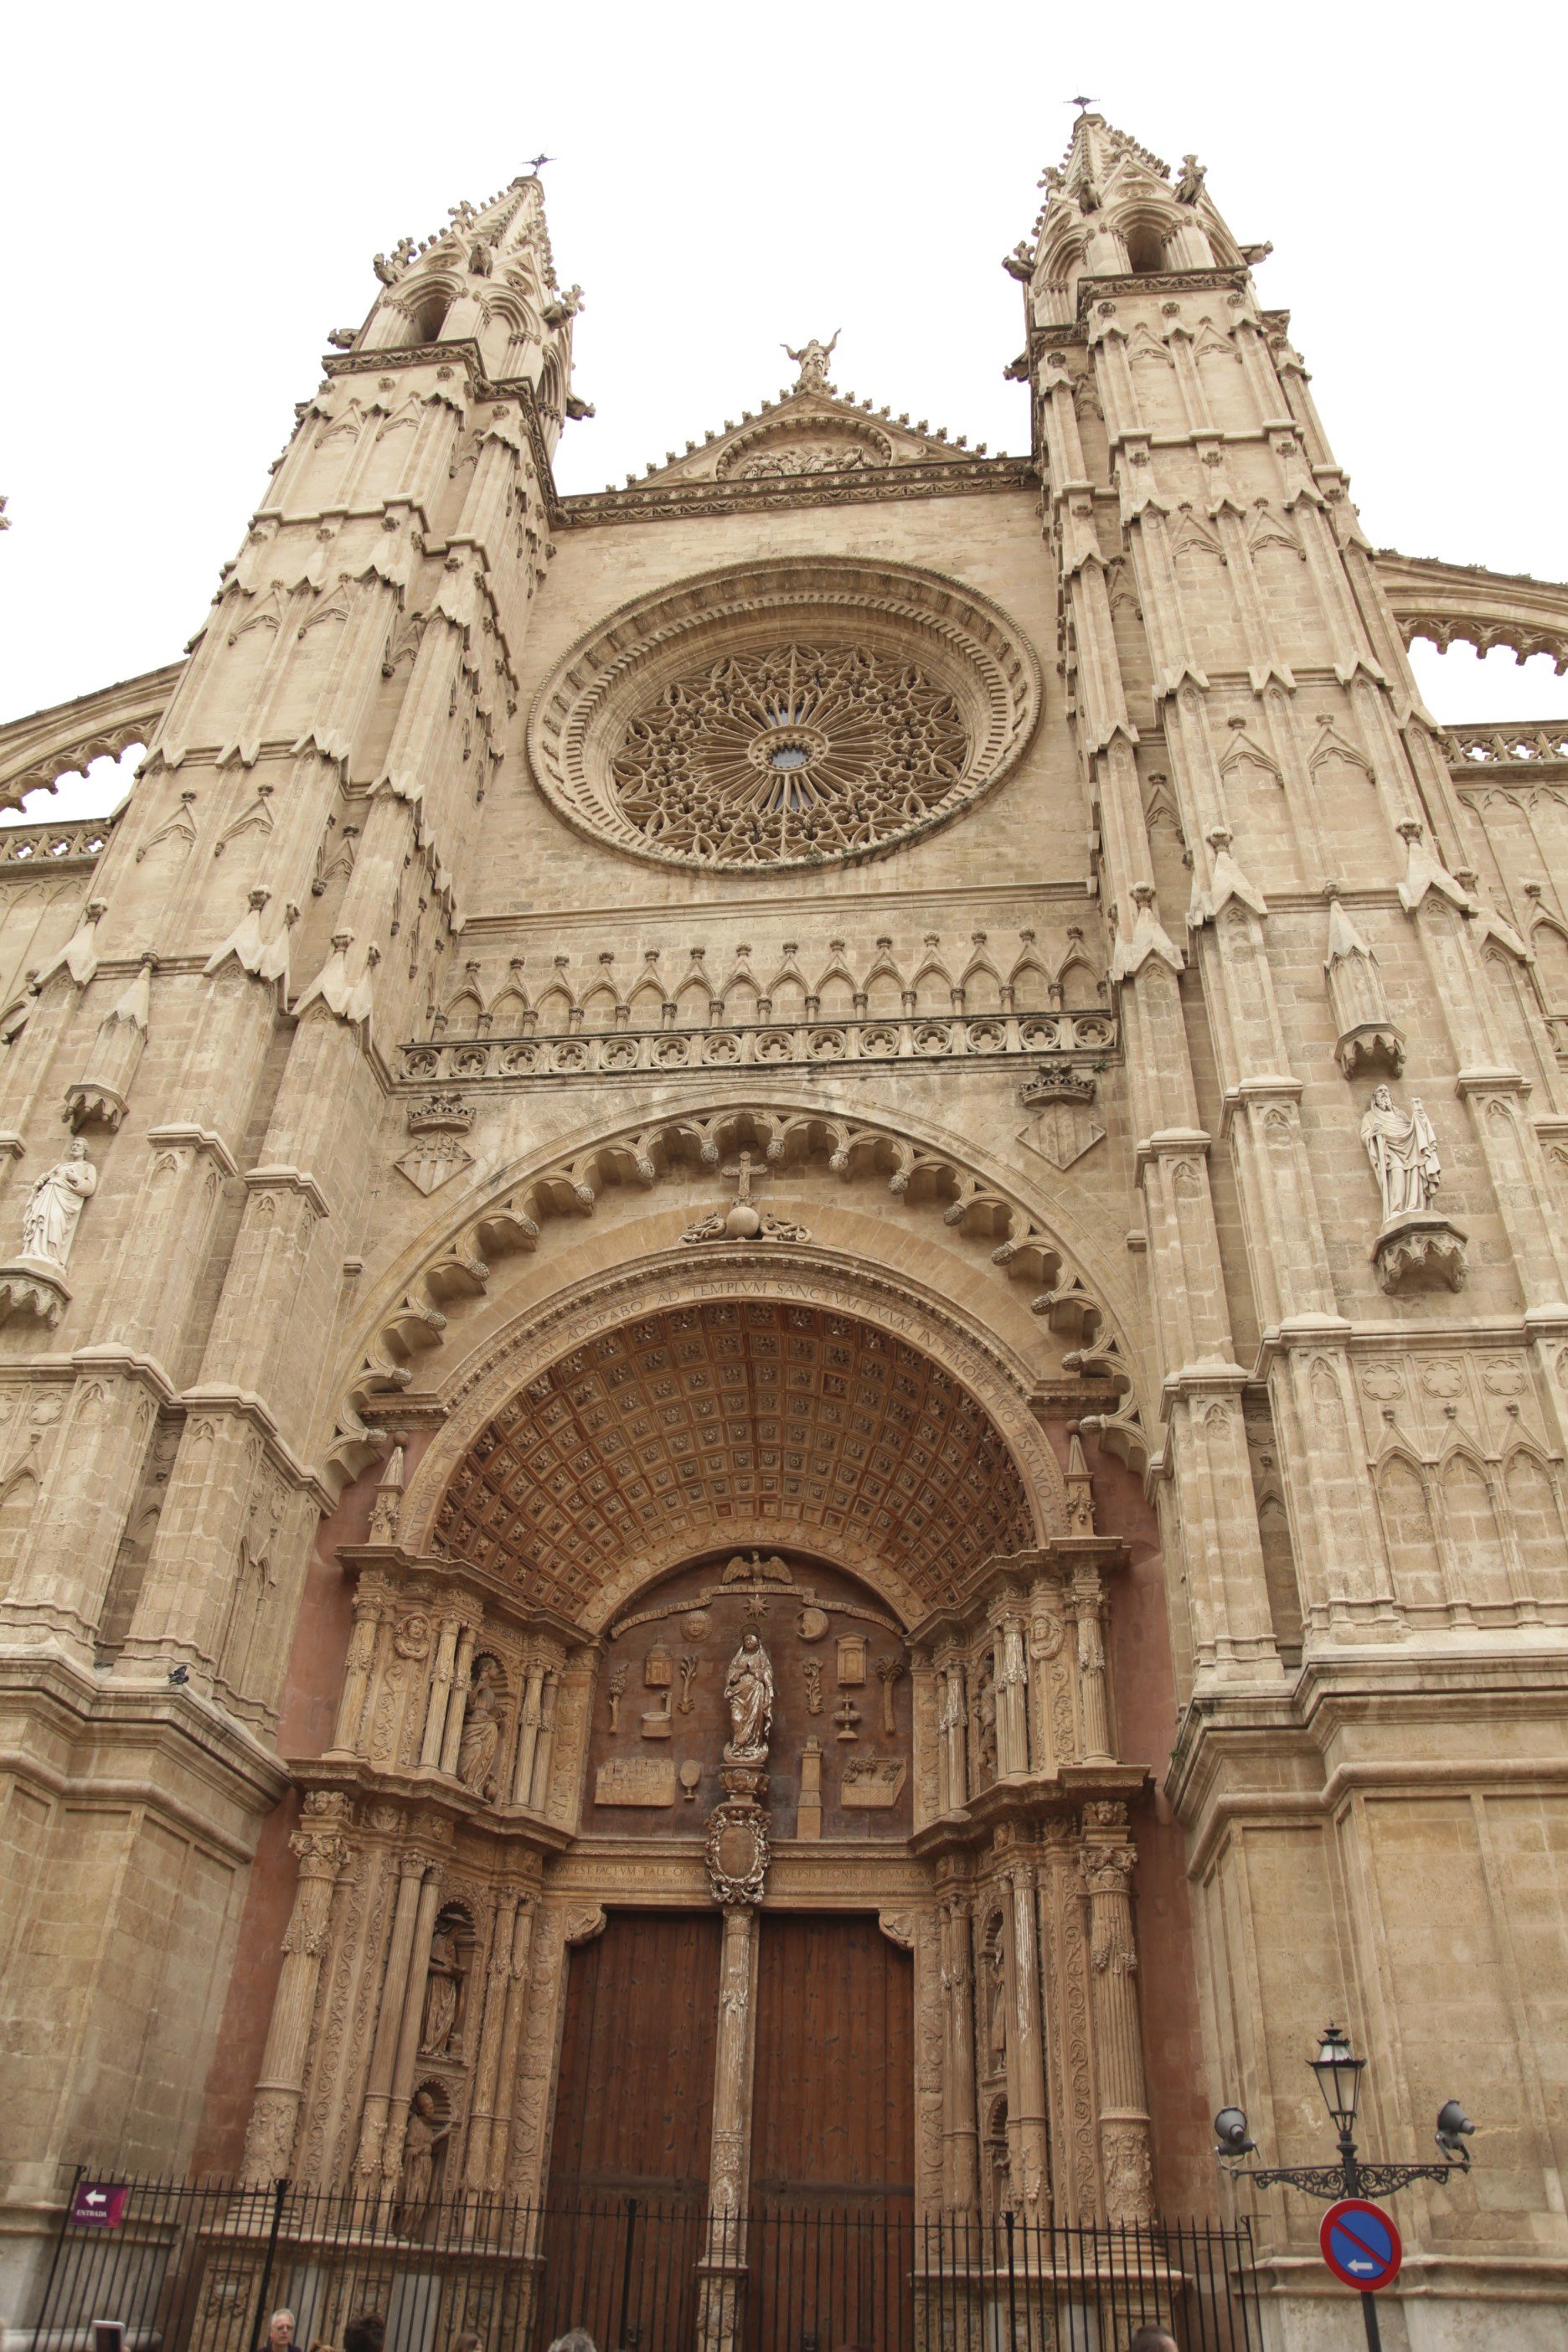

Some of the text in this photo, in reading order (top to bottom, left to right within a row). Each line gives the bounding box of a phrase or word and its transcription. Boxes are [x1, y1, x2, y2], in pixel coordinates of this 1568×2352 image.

[405, 1471, 444, 1549] INTROIBO
[442, 1445, 459, 1462] IN
[458, 1384, 511, 1440] DOMVM
[510, 1344, 558, 1380] TVAM
[565, 1300, 644, 1345] ADORABO
[657, 1289, 681, 1306] AD
[692, 1281, 768, 1297] TEMPLVM
[776, 1282, 859, 1310] SANCTVM
[865, 1302, 913, 1334] TVVM
[917, 1328, 937, 1348] IN
[938, 1343, 991, 1394] TIMORE
[986, 1390, 1016, 1423] TVO
[1013, 1431, 1053, 1498] PSALMO
[574, 1864, 592, 1875] EST
[596, 1865, 637, 1876] FACTVM
[641, 1866, 669, 1877] TALE
[673, 1866, 699, 1878] OPVS
[772, 1868, 817, 1879] NIVERSIS
[76, 2209, 107, 2218] ENTRADA
